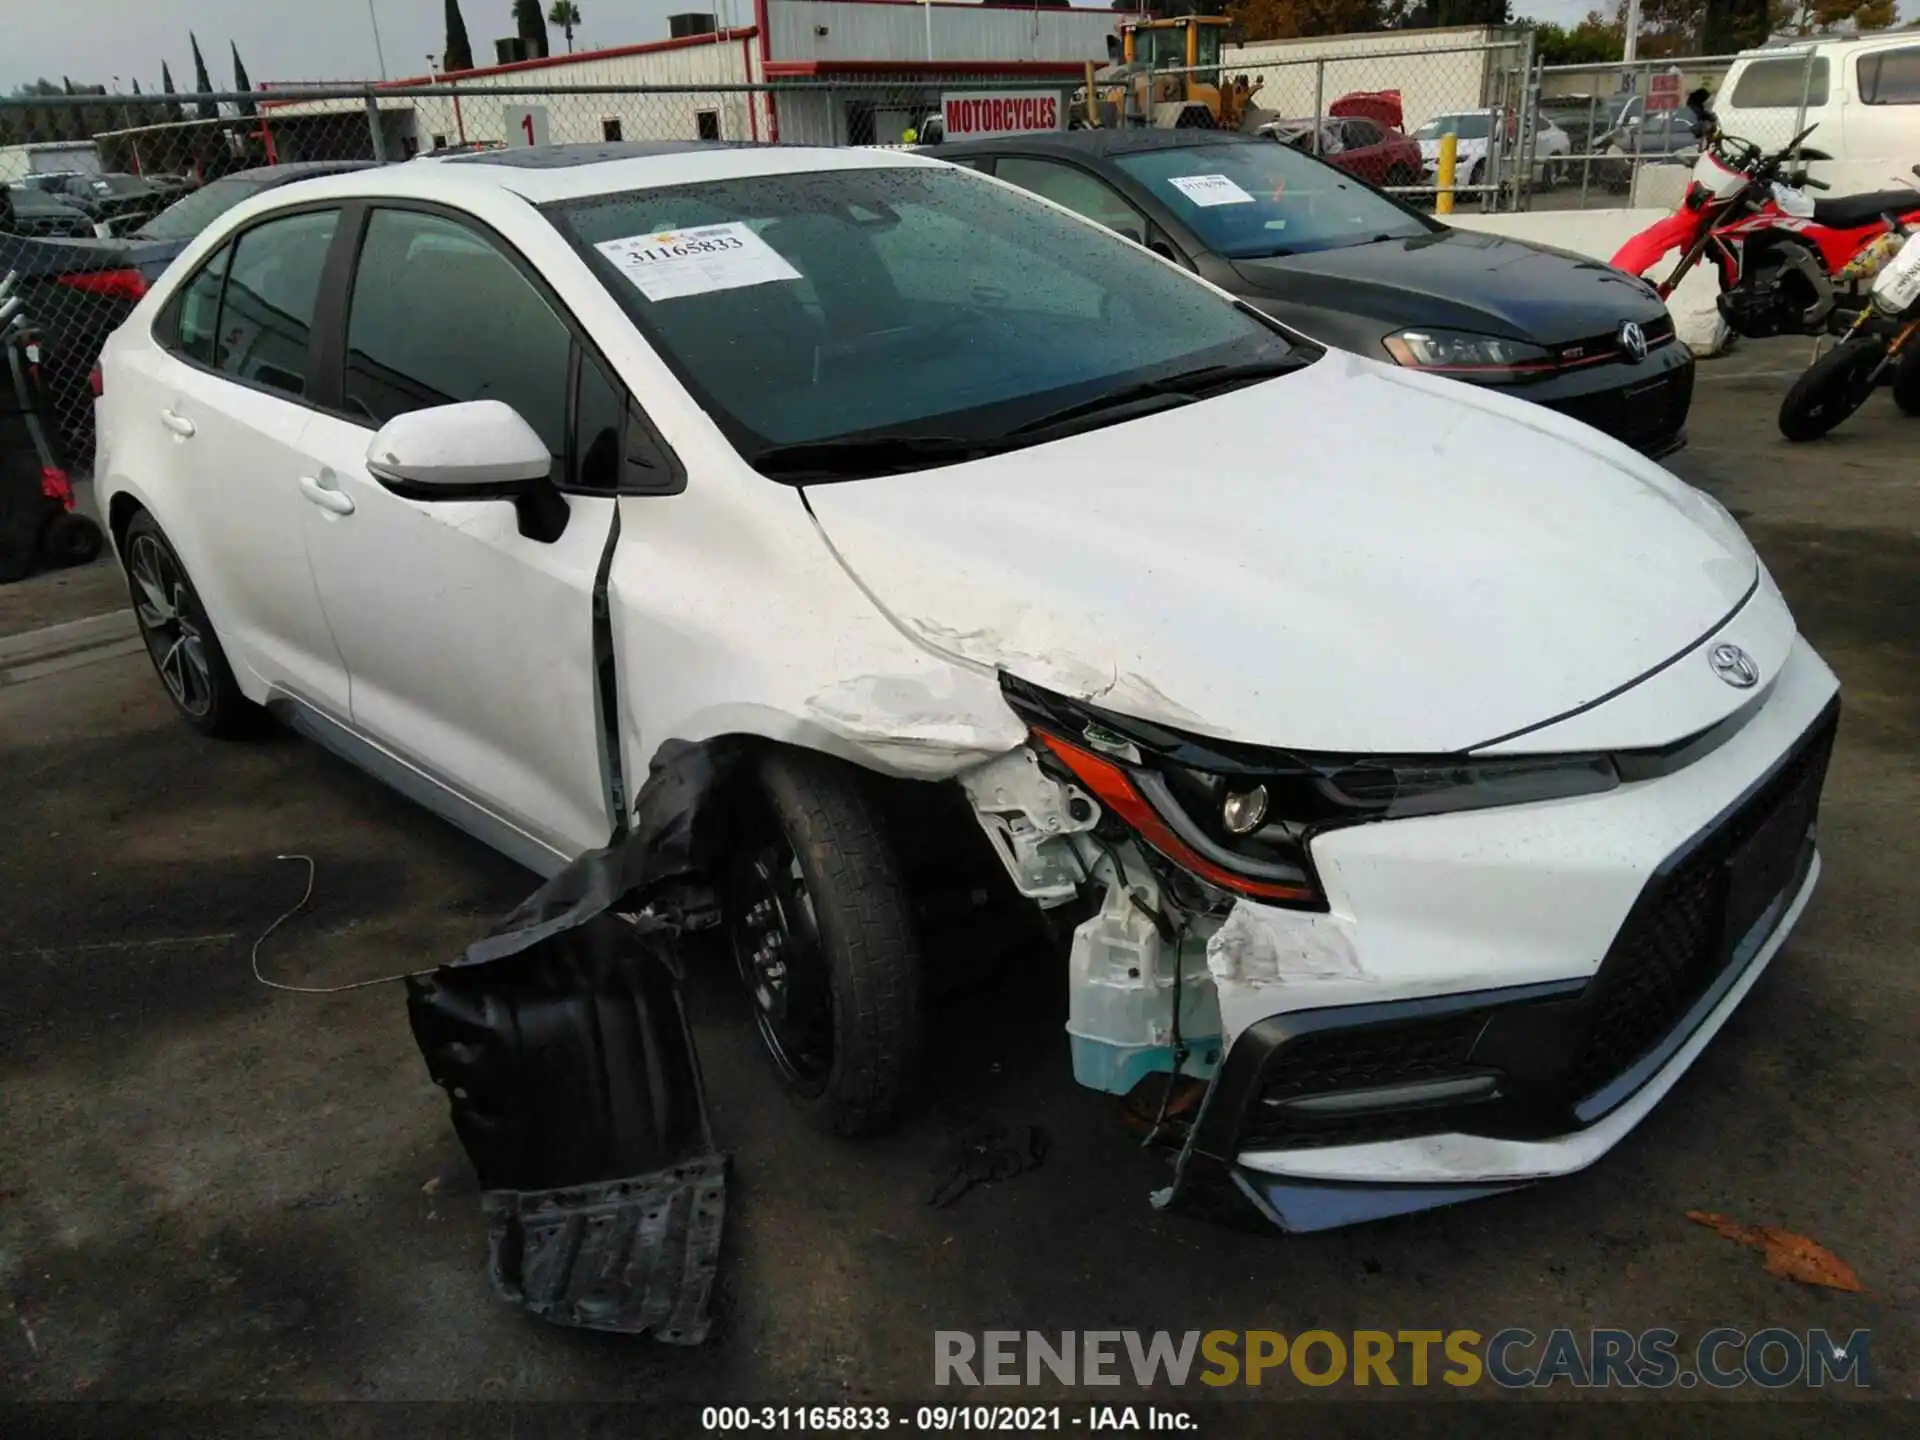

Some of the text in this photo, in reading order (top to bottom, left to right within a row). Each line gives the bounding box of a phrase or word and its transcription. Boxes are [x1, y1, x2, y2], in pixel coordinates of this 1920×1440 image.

[521, 113, 535, 146] 1
[946, 97, 1057, 133] MOTORCYCLES
[626, 236, 744, 264] 31165833
